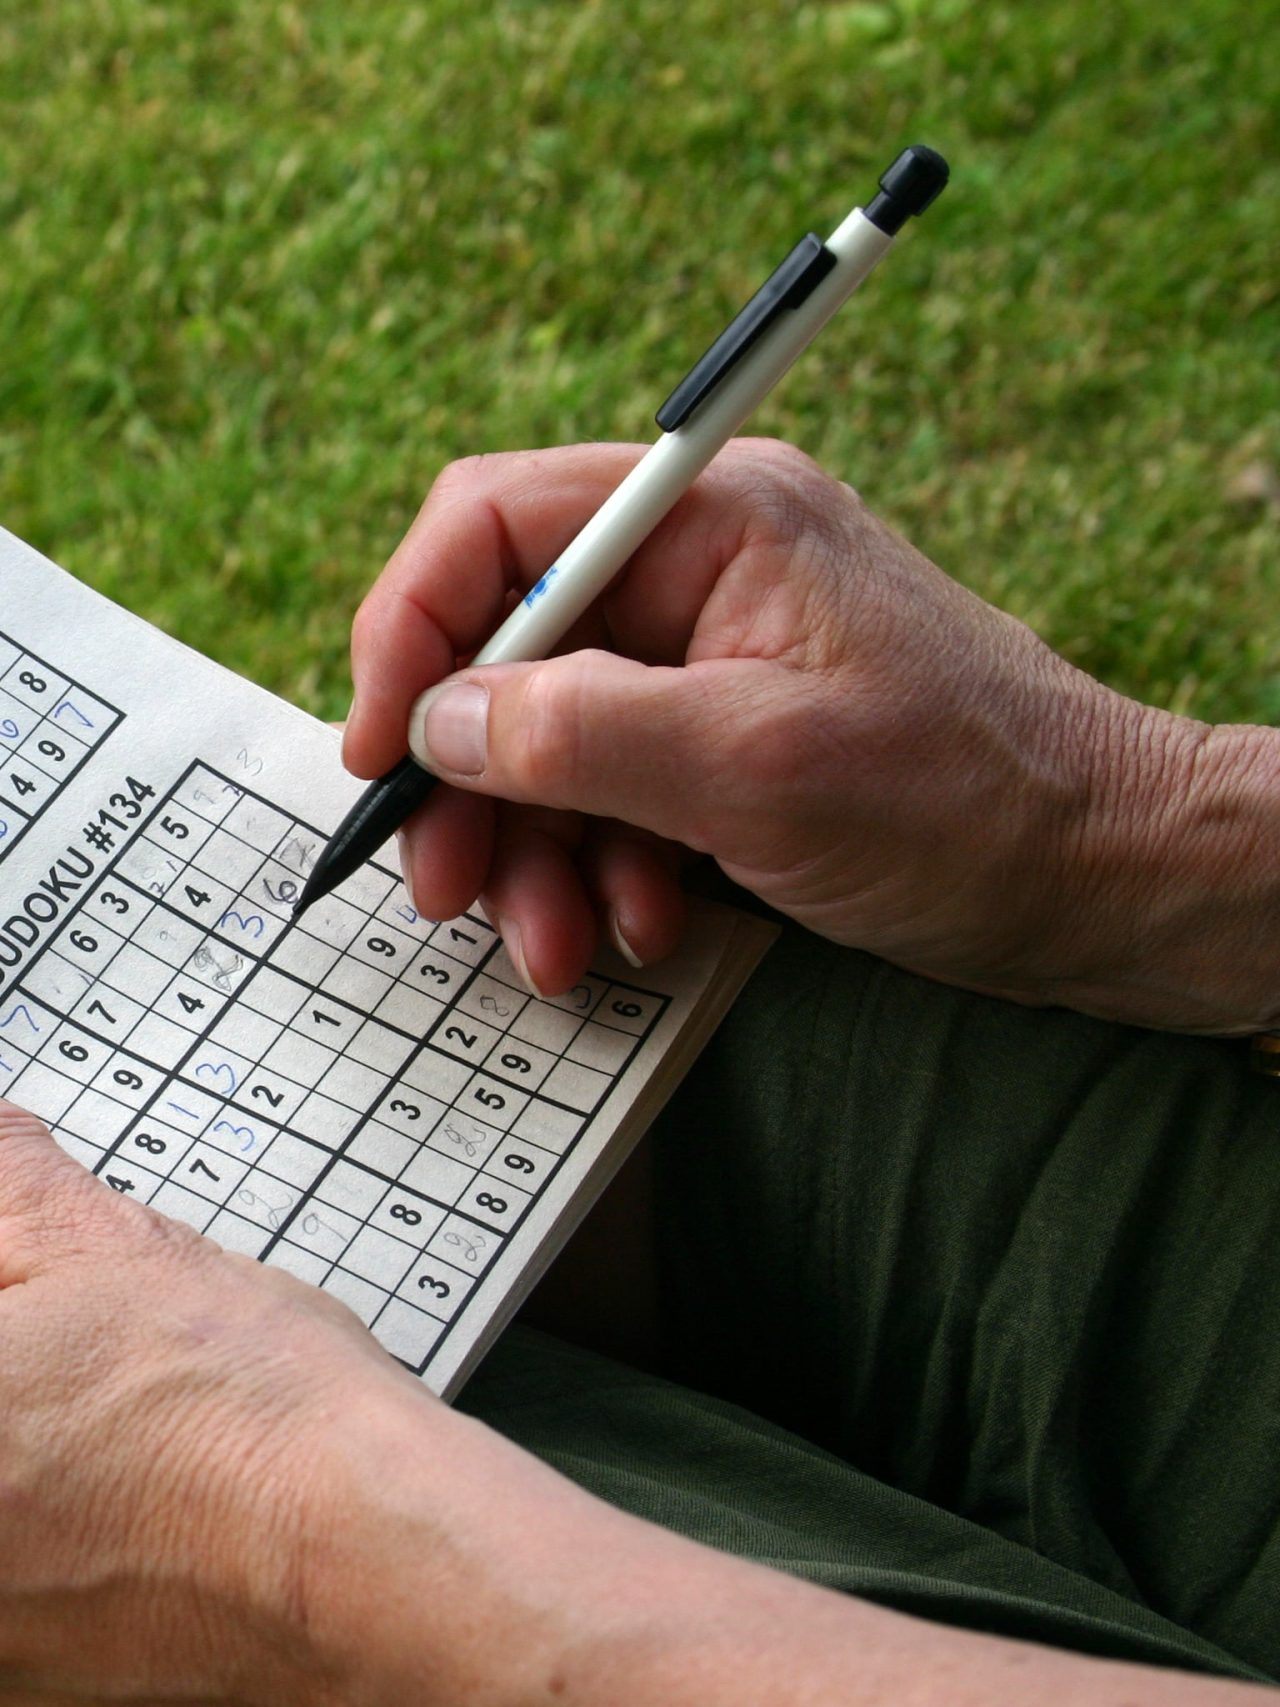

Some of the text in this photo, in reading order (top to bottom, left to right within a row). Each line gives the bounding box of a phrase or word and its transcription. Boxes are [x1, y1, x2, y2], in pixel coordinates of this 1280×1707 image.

[19, 672, 46, 693] 8
[54, 701, 93, 727] 7
[10, 741, 65, 795] 4 9
[82, 776, 157, 854] #134
[70, 930, 98, 952] 6
[101, 892, 129, 914] 3
[160, 816, 189, 839] 5
[219, 912, 265, 939] 3
[59, 1041, 88, 1061] 6
[87, 1000, 116, 1024] 7
[185, 885, 211, 907] 4
[421, 928, 477, 984] 3 1
[0, 1005, 39, 1032] 7
[113, 993, 205, 1090] 9 4
[252, 938, 396, 1107] 2 1 9
[169, 1063, 238, 1119] 1 3
[390, 1027, 477, 1120] 3 2
[474, 1054, 531, 1109] 5 9
[476, 1000, 642, 1213] 8 9 6
[106, 1134, 166, 1193] 4 8
[211, 1121, 256, 1151] 3
[189, 1159, 220, 1181] 7
[390, 1204, 421, 1225] 8
[418, 1276, 450, 1298] 3
